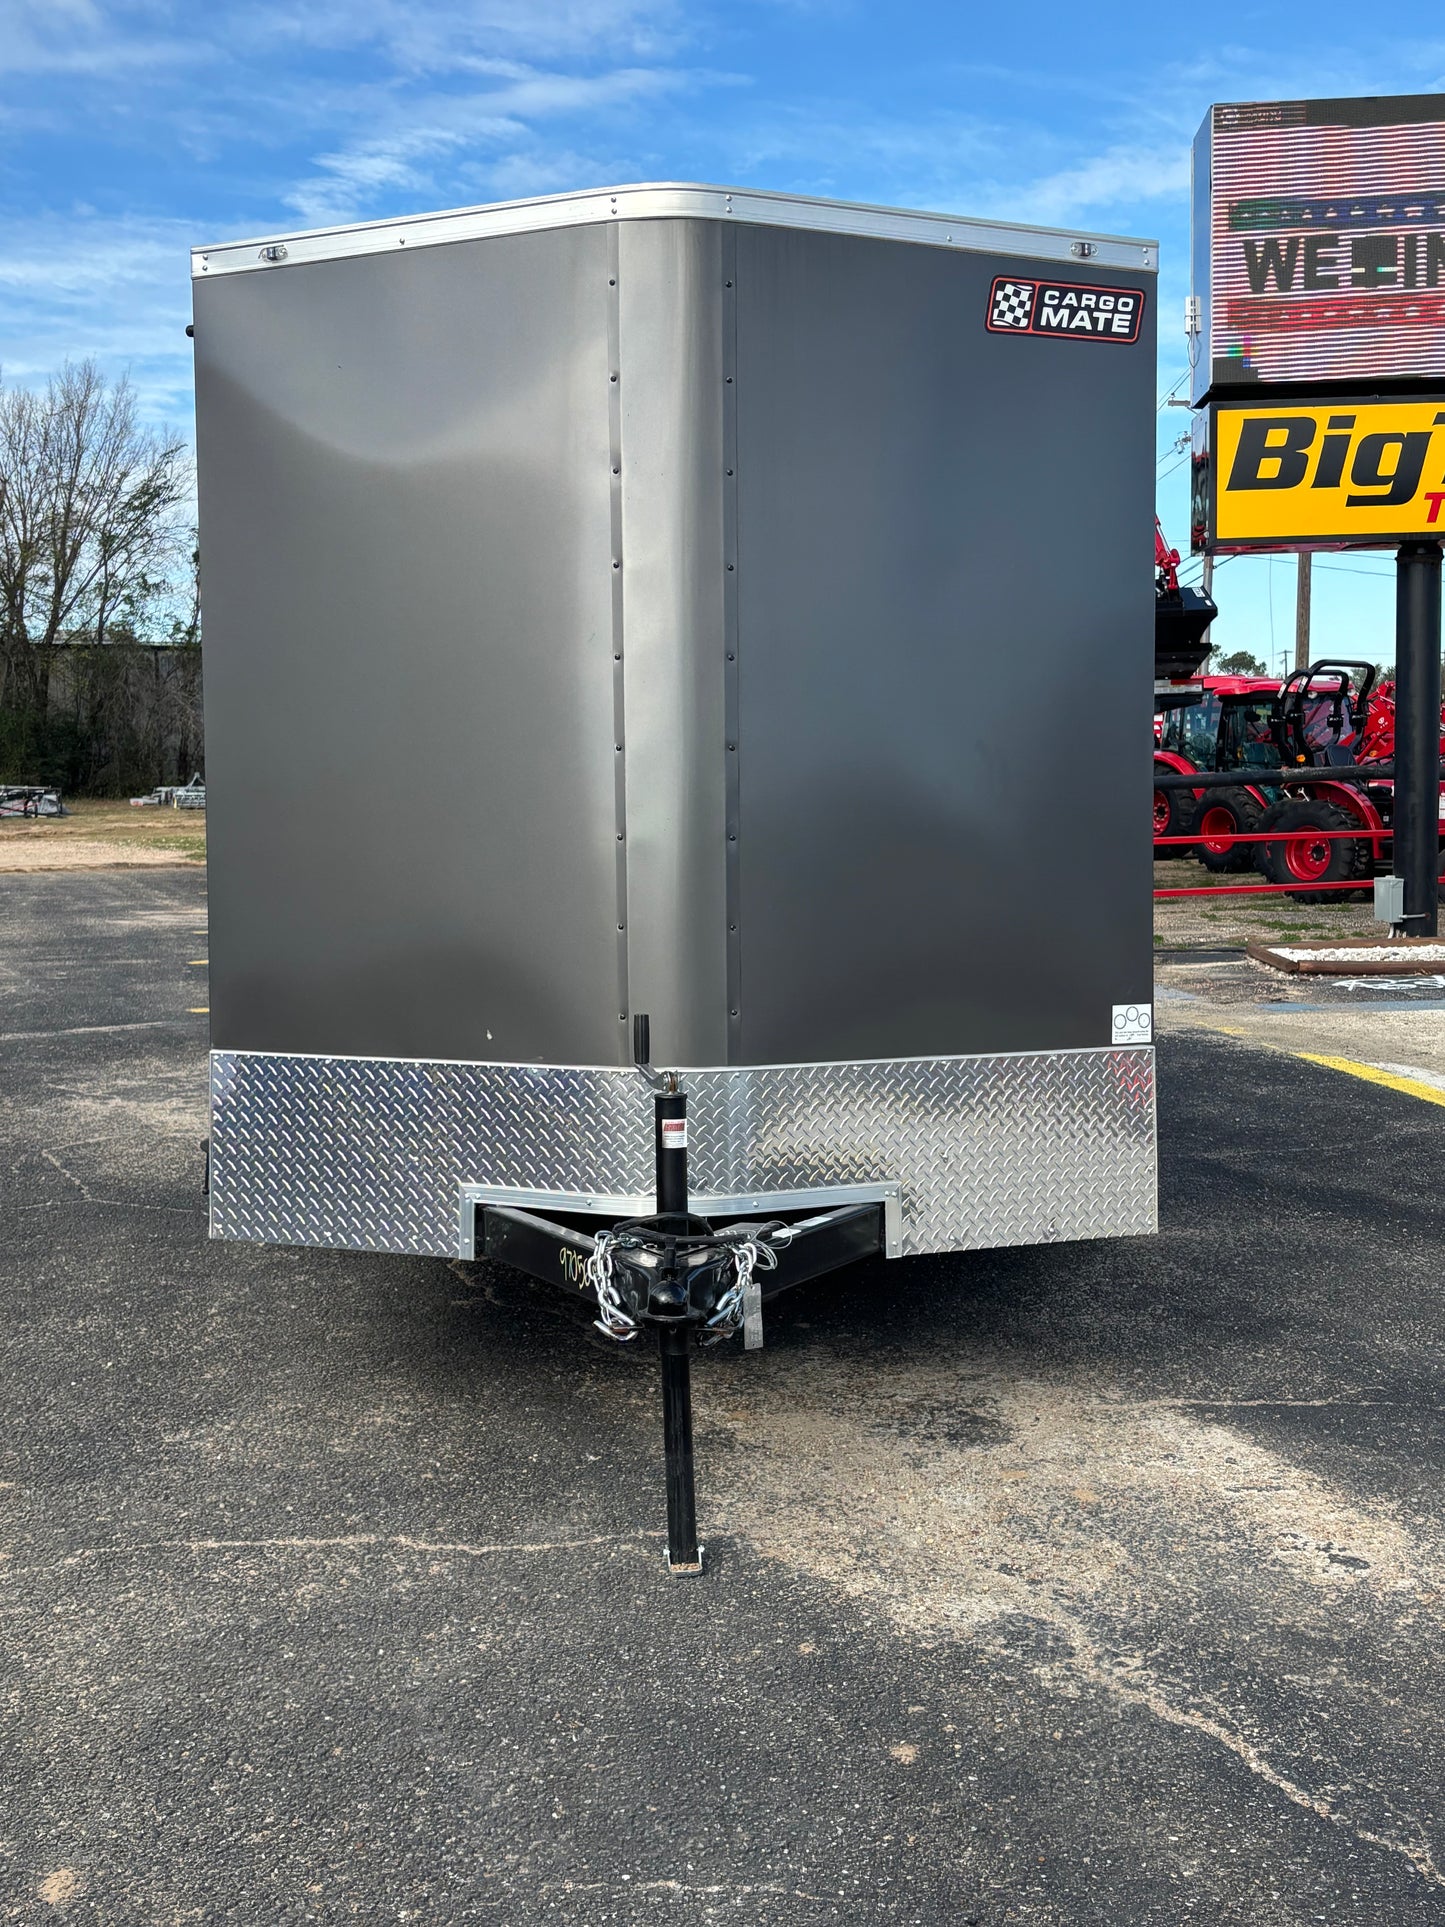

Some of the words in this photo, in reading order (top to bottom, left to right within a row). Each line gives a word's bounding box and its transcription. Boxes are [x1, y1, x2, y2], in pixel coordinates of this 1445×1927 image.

[1243, 236, 1341, 293] WE
[1040, 306, 1132, 334] MATE
[1043, 290, 1134, 312] CARGO
[1226, 411, 1445, 507] Big
